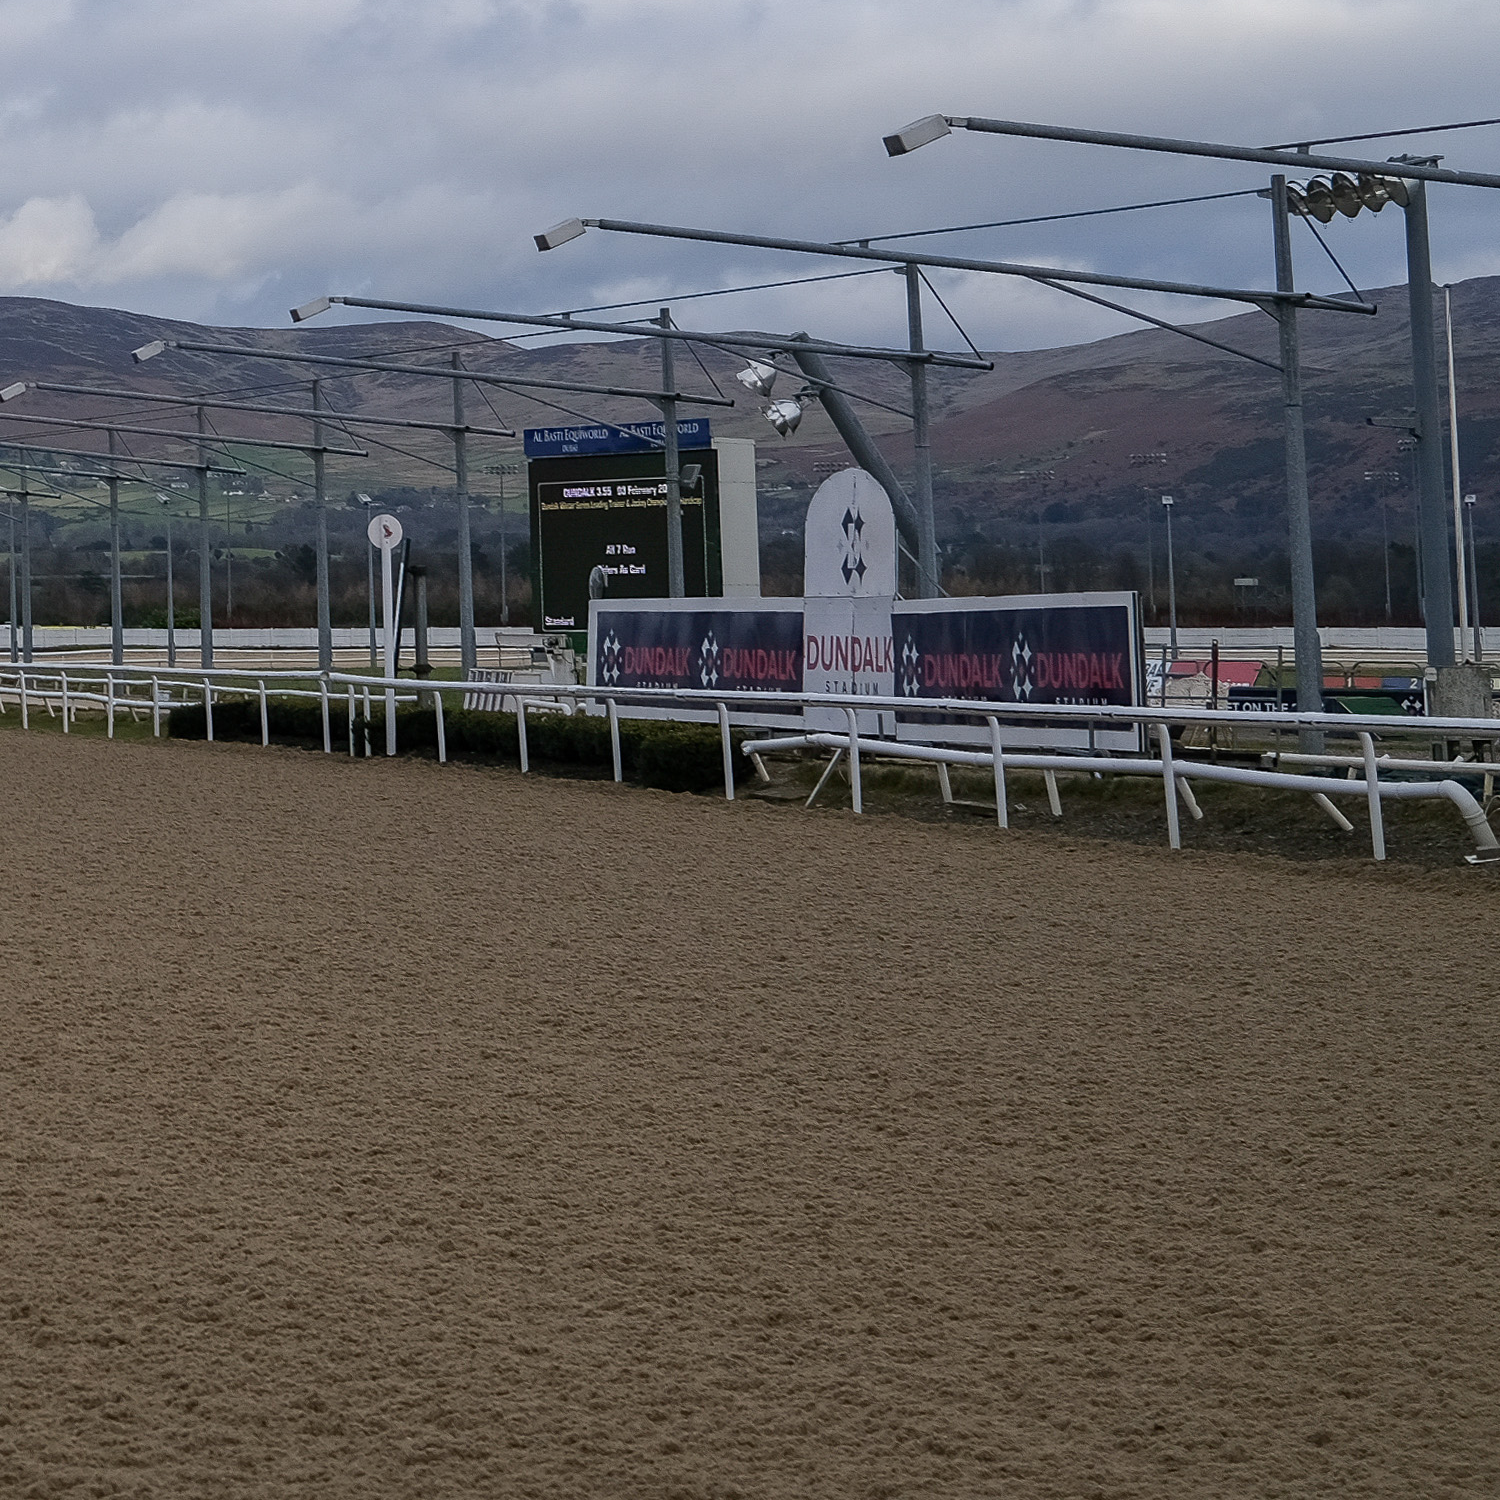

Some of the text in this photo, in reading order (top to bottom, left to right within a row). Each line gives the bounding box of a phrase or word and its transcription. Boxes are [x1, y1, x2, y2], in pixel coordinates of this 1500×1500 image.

[533, 428, 609, 443] AL BASTI EQUIWORLD
[624, 646, 691, 676] DUNDALK
[723, 647, 797, 681] DUNDALK
[807, 635, 895, 673] DUNDALK
[924, 653, 1003, 688] DUNDALK
[1036, 652, 1124, 690] DUNDALK
[825, 680, 880, 696] STADIUM
[1346, 677, 1352, 688] 1
[1409, 678, 1418, 689] 2
[1227, 702, 1240, 712] ET
[1242, 702, 1261, 712] ON
[1264, 702, 1289, 712] THE
